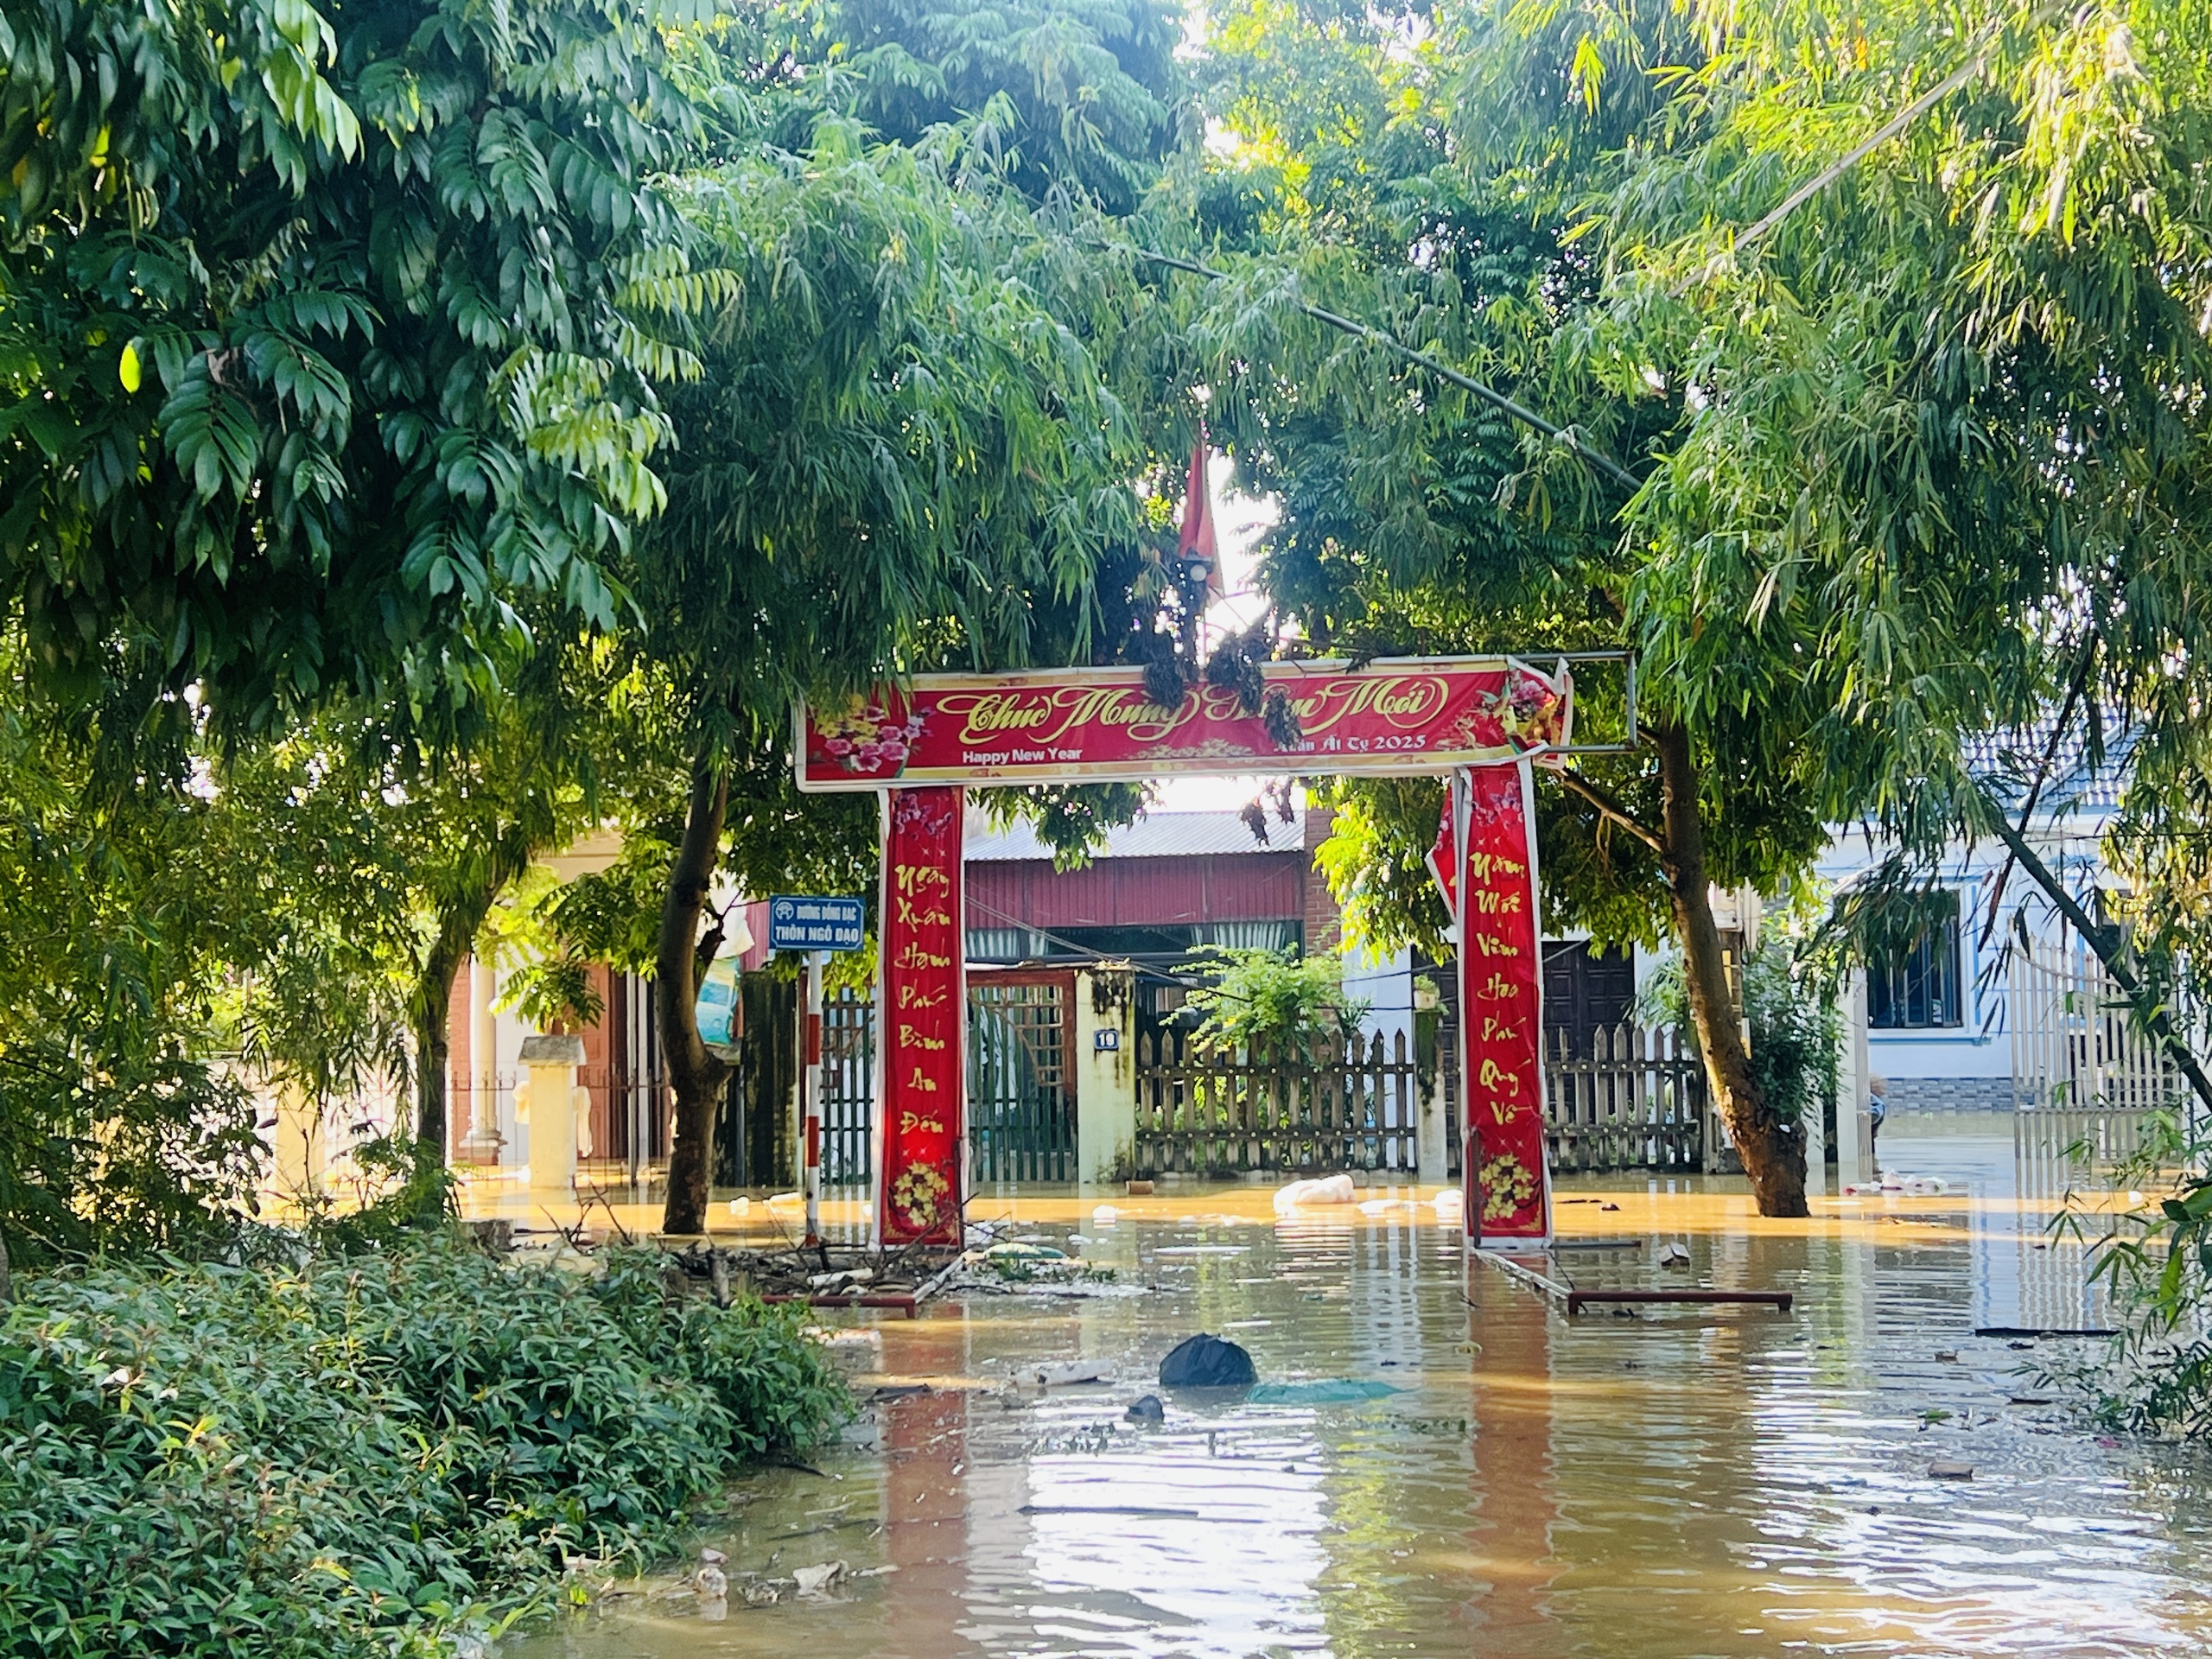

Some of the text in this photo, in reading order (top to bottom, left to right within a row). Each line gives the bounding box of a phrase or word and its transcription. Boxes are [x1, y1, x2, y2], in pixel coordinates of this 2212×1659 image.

[936, 692, 1052, 745] Chúc
[1201, 682, 1326, 722] Nm
[1299, 677, 1449, 736] Mới
[1374, 734, 1427, 750] 2025
[963, 747, 1084, 765] Happy New Year
